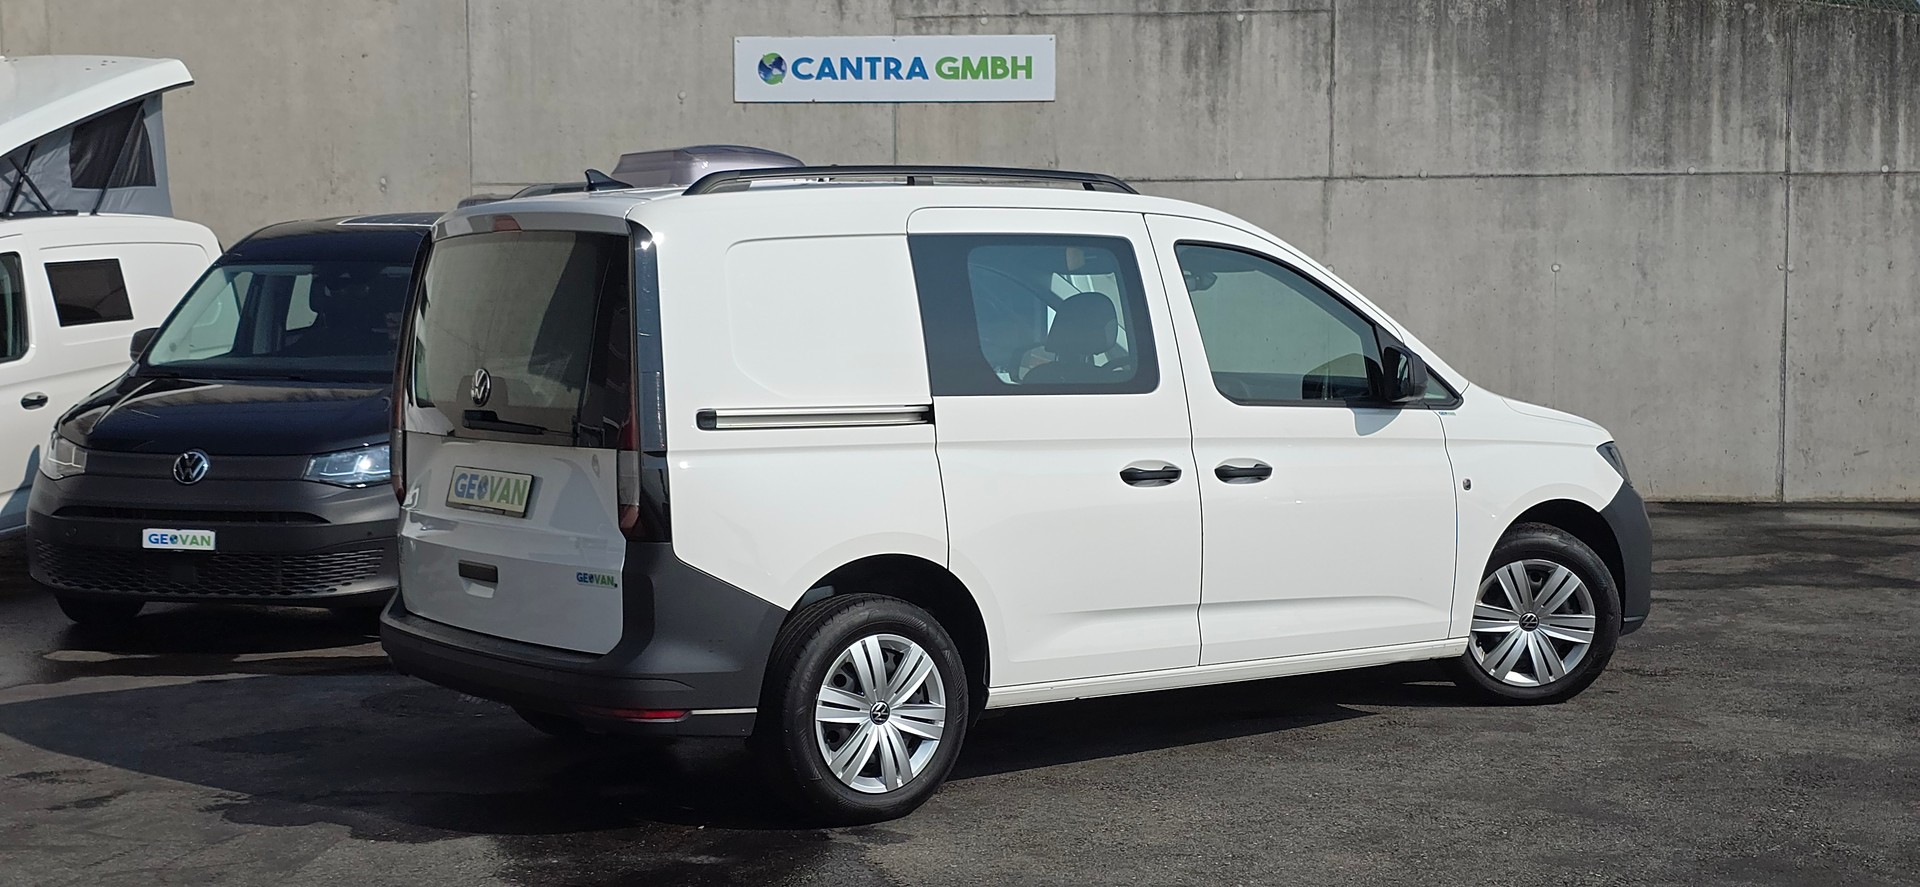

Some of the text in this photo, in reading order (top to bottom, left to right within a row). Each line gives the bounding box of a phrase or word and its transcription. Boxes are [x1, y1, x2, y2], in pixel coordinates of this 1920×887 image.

[791, 55, 1033, 81] CANTRA GMBH
[454, 472, 529, 506] GEOVAN
[148, 533, 211, 547] GEOVAN
